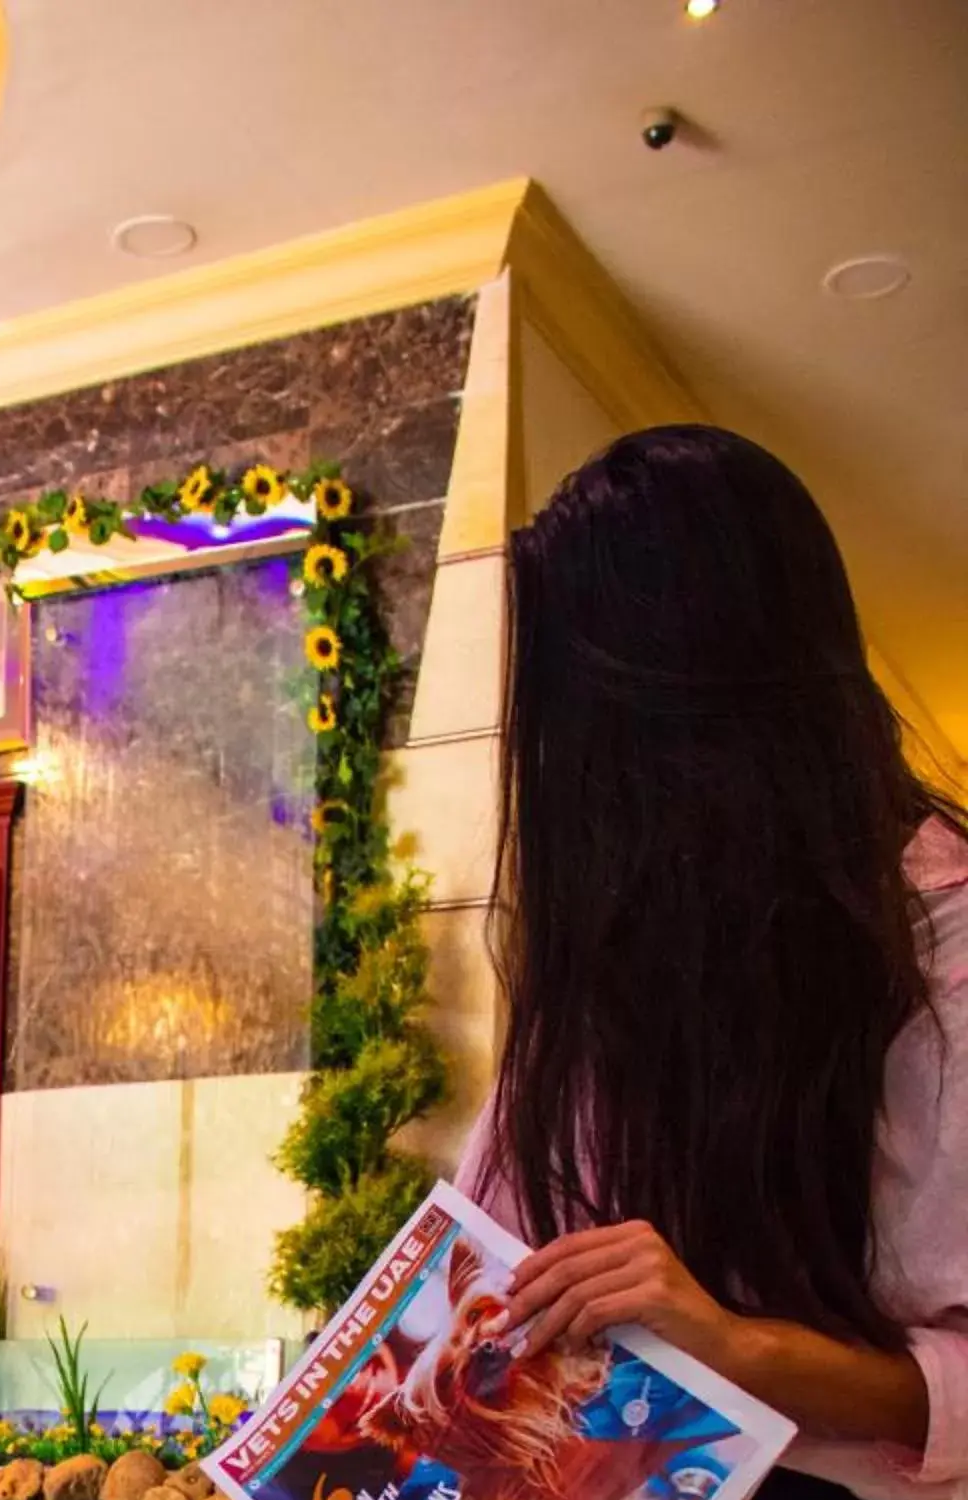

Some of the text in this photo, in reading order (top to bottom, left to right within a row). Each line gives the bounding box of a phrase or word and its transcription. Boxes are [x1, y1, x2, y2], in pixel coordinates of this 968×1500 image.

[226, 1391, 303, 1476] VETS
[292, 1359, 331, 1400] IN
[320, 1299, 380, 1365] THE
[365, 1234, 429, 1304] UAE
